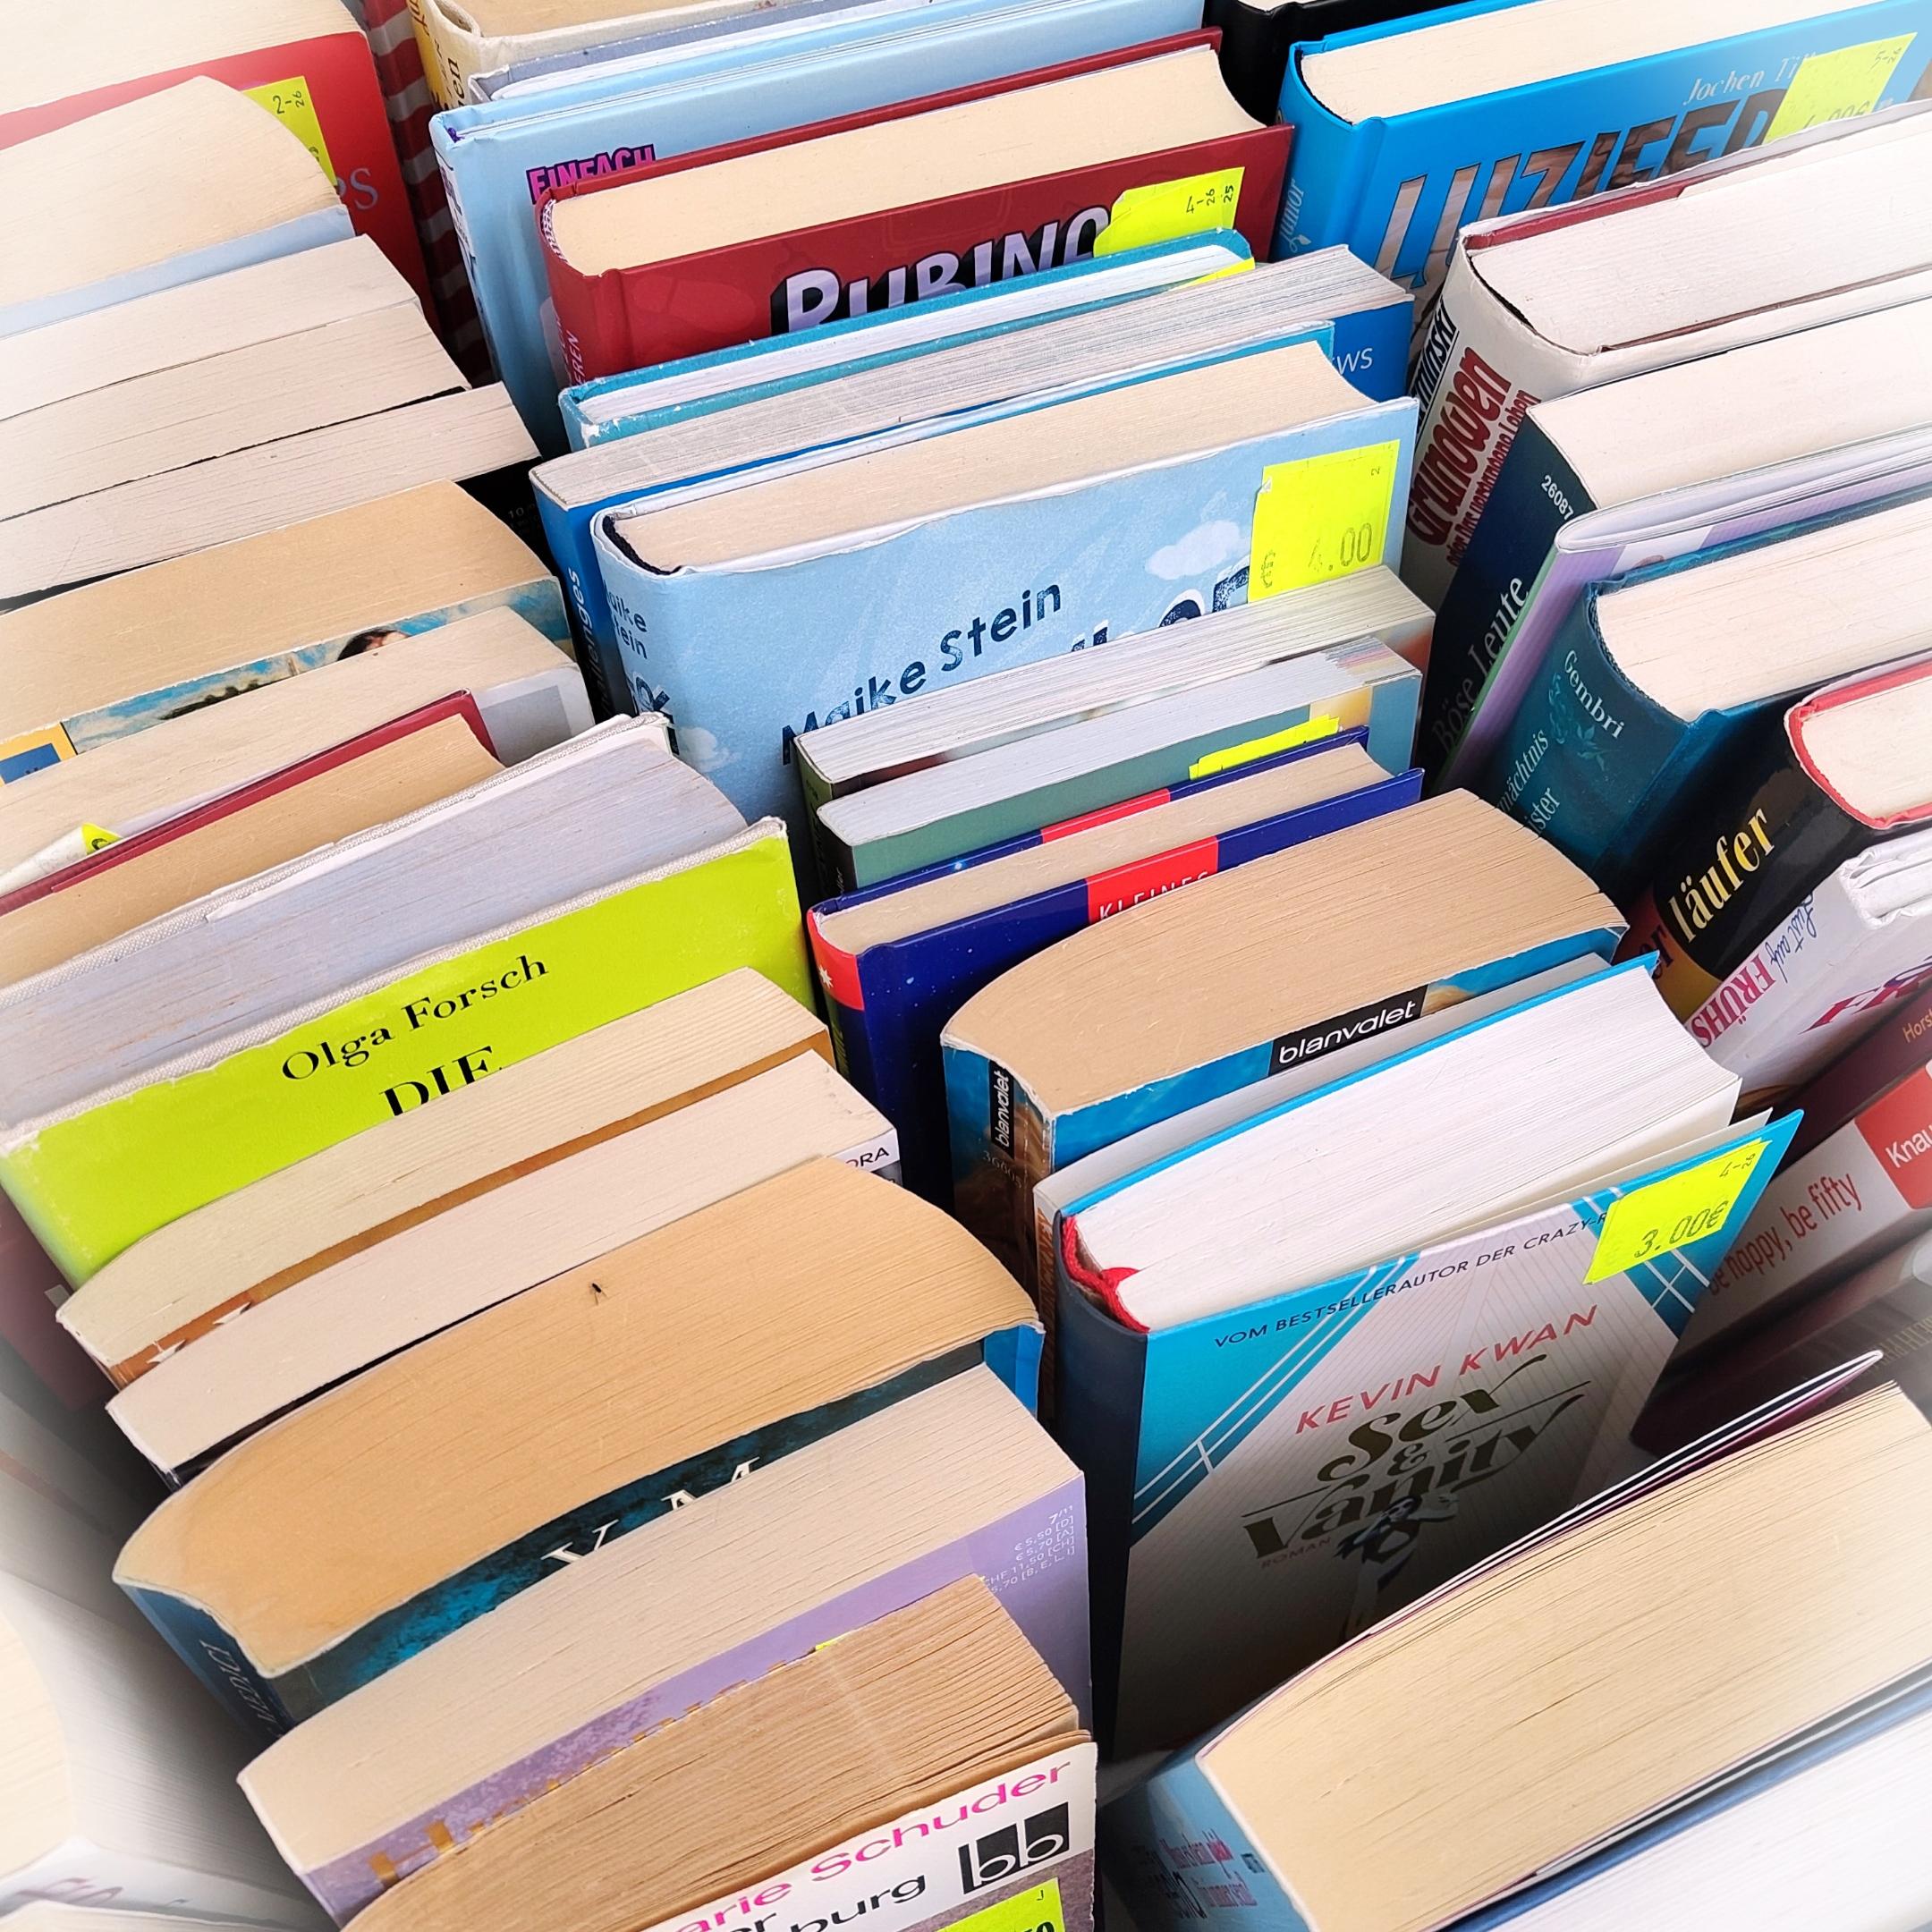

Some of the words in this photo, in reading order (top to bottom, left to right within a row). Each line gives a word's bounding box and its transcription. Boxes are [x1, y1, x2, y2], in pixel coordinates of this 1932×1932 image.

[1683, 69, 1766, 106] Jochen
[1407, 346, 1513, 547] Grunowen
[1541, 475, 1574, 521] 26087
[940, 583, 1062, 673] Stein
[1468, 577, 1530, 678] Leute
[1564, 649, 1625, 740] Gembri
[1668, 808, 1775, 944] läufer
[282, 1028, 395, 1080] Olga
[401, 954, 549, 1032] Forsch
[1278, 999, 1419, 1066] blanvalet
[994, 1070, 1012, 1149] blanvalet
[1633, 1199, 1730, 1259] 3.00€
[1779, 1206, 1818, 1239] be
[1807, 1173, 1862, 1222] fifty
[1214, 1323, 1268, 1348] VOM
[1275, 1259, 1470, 1334] BESTSELLERAUTOR
[1476, 1243, 1516, 1268] DER
[1295, 1364, 1442, 1436] KEVIN
[1458, 1303, 1598, 1377] KWAN
[1260, 1536, 1333, 1570] ROMAN
[810, 1761, 1072, 1883] Schuder
